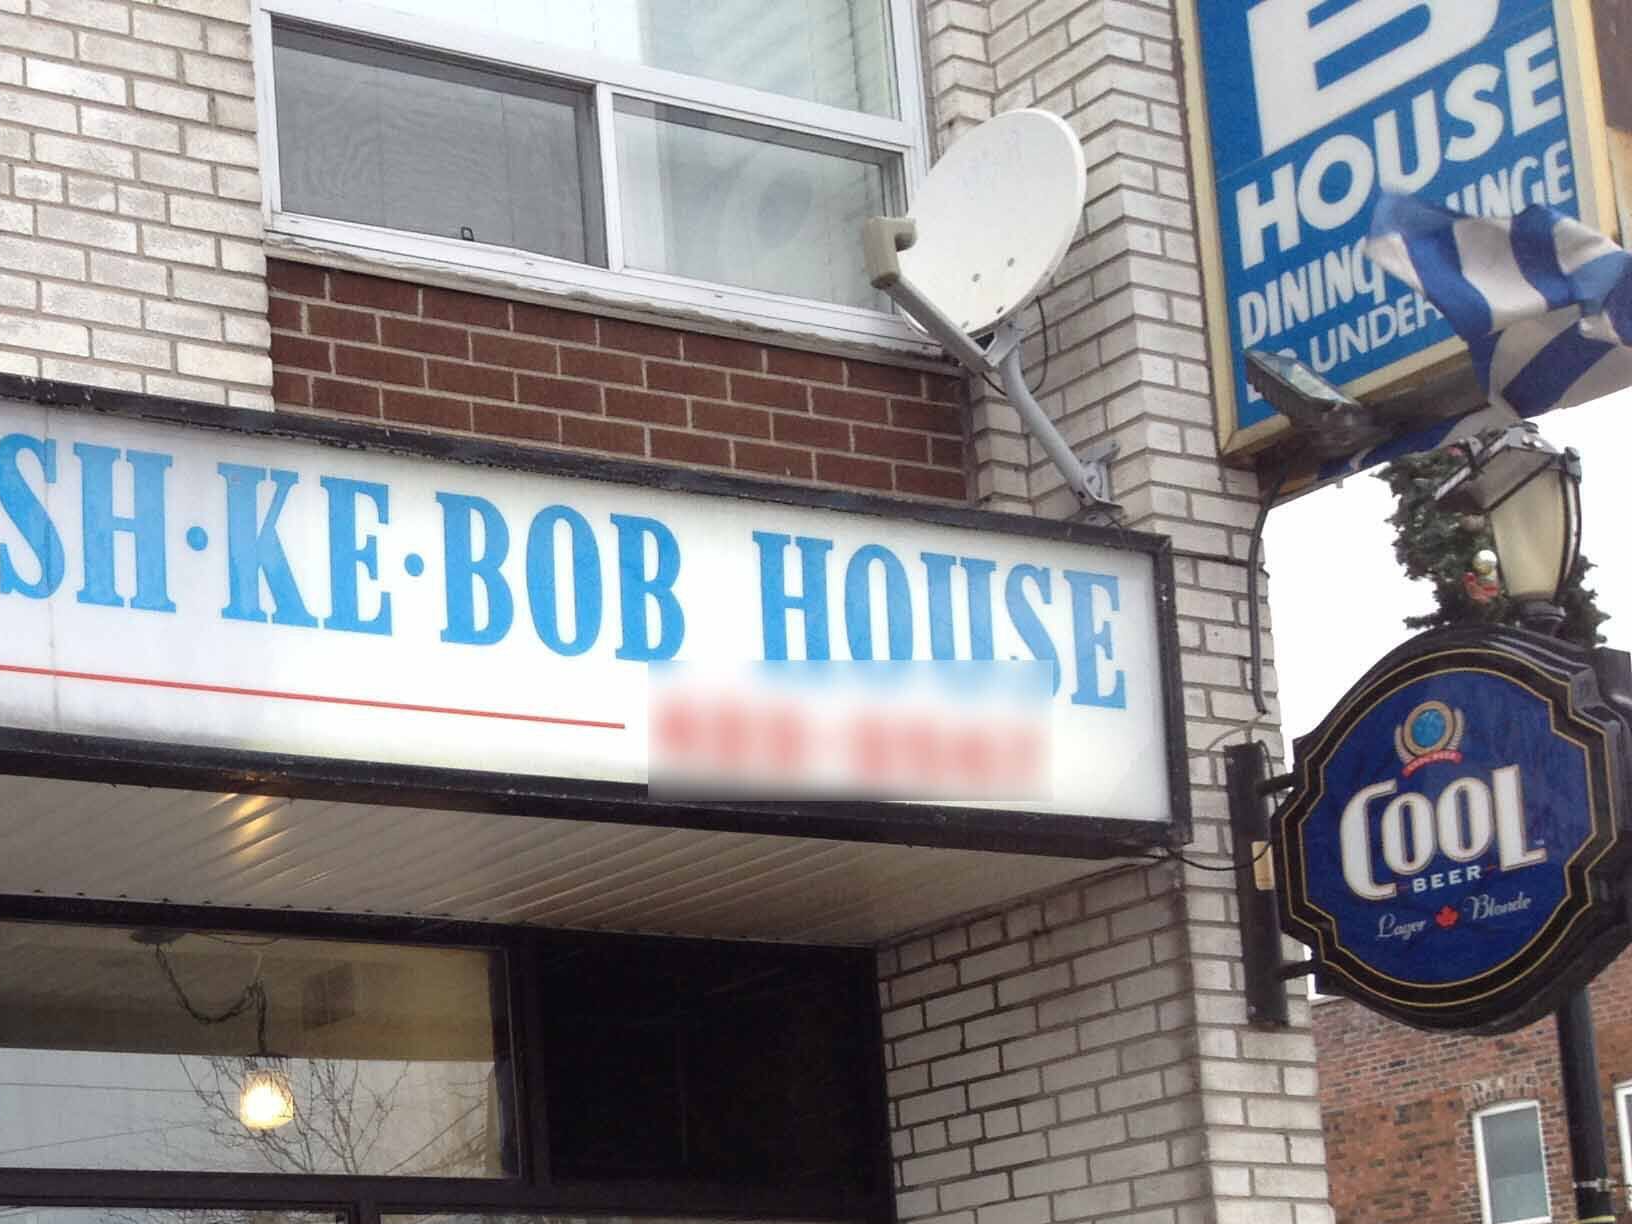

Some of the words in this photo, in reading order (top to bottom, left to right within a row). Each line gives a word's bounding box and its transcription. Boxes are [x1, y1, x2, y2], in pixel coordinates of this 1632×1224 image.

[1236, 28, 1562, 270] HOUSE
[752, 531, 1127, 709] HOUSE
[1376, 913, 1427, 941] Lager
[1464, 892, 1532, 921] Blonde
[1412, 865, 1482, 893] BEER
